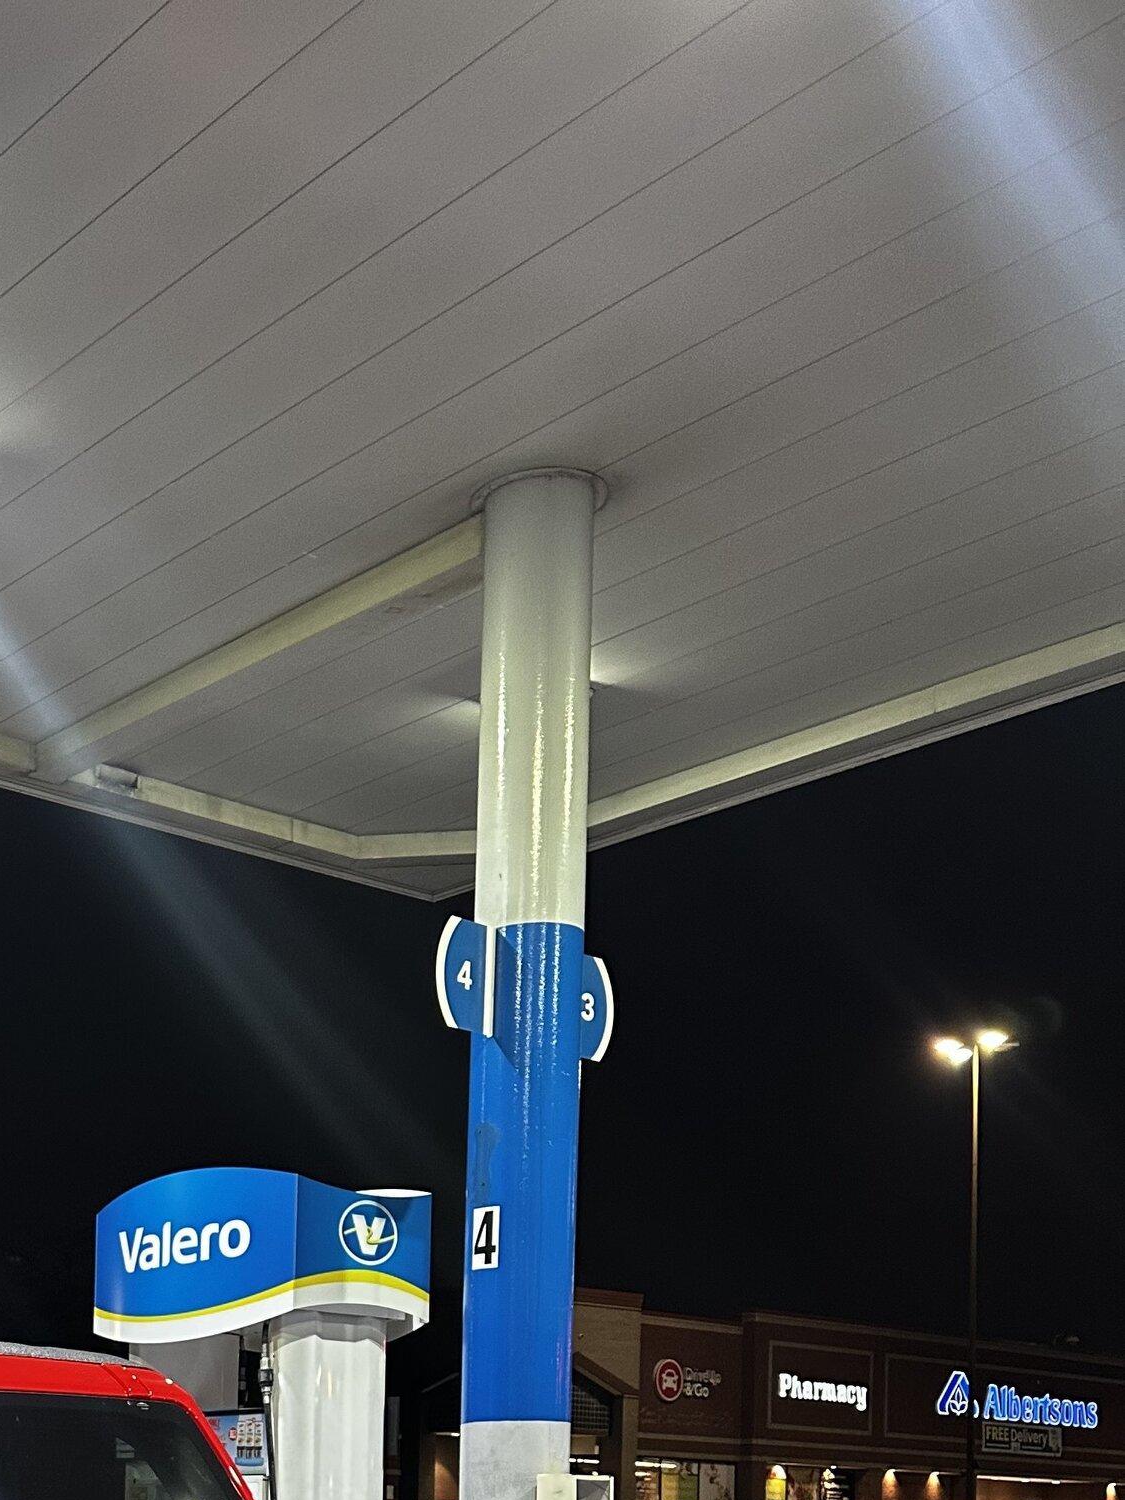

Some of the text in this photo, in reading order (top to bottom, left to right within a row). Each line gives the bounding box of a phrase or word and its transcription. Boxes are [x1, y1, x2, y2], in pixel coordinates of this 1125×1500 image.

[456, 960, 473, 991] 4
[580, 992, 595, 1022] 3
[118, 1218, 251, 1274] Valero
[473, 1210, 497, 1265] 4
[778, 1373, 867, 1411] Pharmacy
[983, 1383, 1098, 1428] Albertsons
[985, 1426, 1010, 1441] FREE
[1010, 1428, 1049, 1447] Delivery
